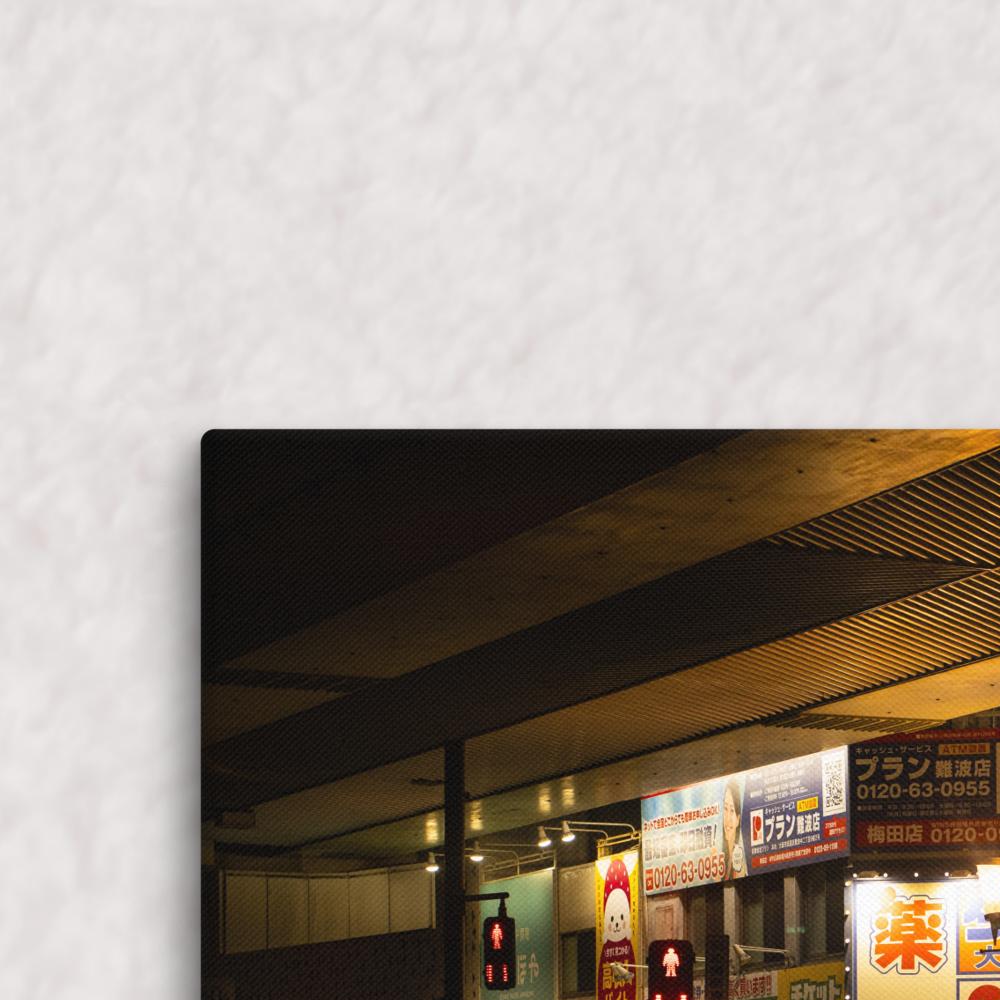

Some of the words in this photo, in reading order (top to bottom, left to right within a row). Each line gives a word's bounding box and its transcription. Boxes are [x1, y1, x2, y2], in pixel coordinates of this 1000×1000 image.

[856, 780, 991, 799] 0120-63-0955
[866, 824, 923, 843] 梅田店
[654, 852, 725, 889] 0120-63-0955
[873, 896, 945, 971] 薬
